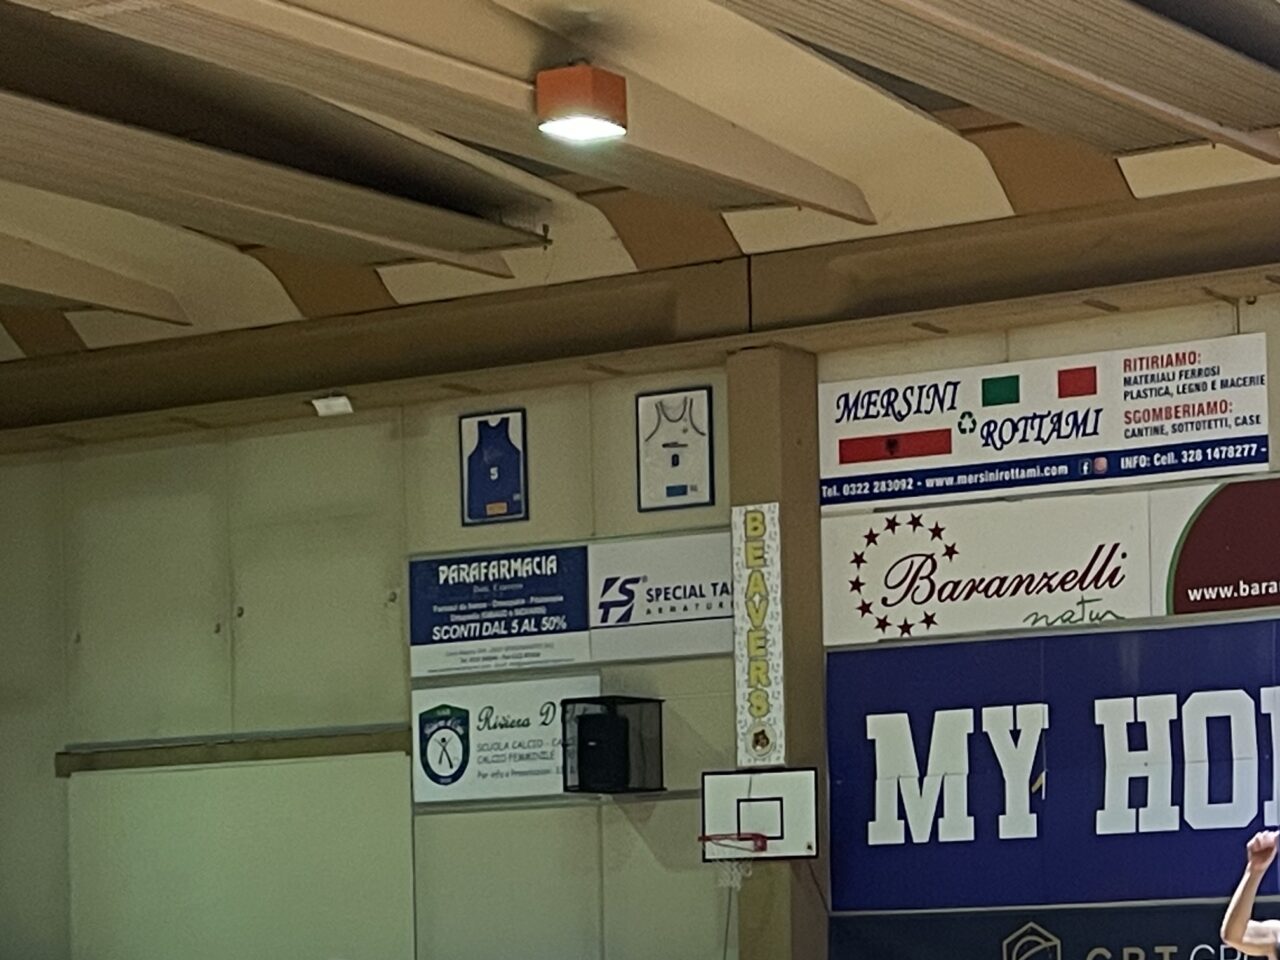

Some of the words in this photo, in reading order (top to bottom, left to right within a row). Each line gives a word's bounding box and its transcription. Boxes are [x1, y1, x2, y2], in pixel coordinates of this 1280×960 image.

[1124, 351, 1201, 373] RITIRIAMO:
[1124, 371, 1176, 387] MATERIALI
[1179, 366, 1220, 381] FERROSI
[1124, 386, 1173, 401] PLASTICA,
[1177, 381, 1207, 395] LEGNO
[1211, 380, 1217, 391] E
[1220, 374, 1265, 390] MACERIE
[835, 380, 961, 425] MERSINI
[1124, 399, 1233, 425] SGOMBERIAMO:
[980, 408, 1104, 450] ROTTAMI
[1124, 424, 1168, 439] CANTINE,
[1171, 417, 1232, 434] SOTTOTETTI,
[1235, 414, 1261, 427] CASE
[490, 467, 498, 480] 5
[821, 485, 839, 498] Tel.
[842, 482, 870, 495] 0322
[873, 478, 913, 493] 283092
[925, 465, 1069, 488] www.mersinirottami.com
[1120, 456, 1150, 470] INFO:
[1154, 452, 1178, 466] Cell.
[1182, 449, 1202, 463] 328
[1206, 443, 1257, 461] 1478277
[438, 555, 557, 585] PARAFARMACIA
[880, 543, 1128, 608] Baranzelli
[646, 584, 706, 603] SPECIAL
[711, 582, 733, 597] TA
[646, 601, 734, 616] ARMATUR
[432, 620, 481, 640] SCONTI
[482, 619, 508, 637] DAL
[511, 618, 519, 634] 5
[521, 616, 538, 633] AL
[540, 615, 567, 631] 50%
[477, 705, 532, 732] Riviera
[866, 703, 1049, 846] MY
